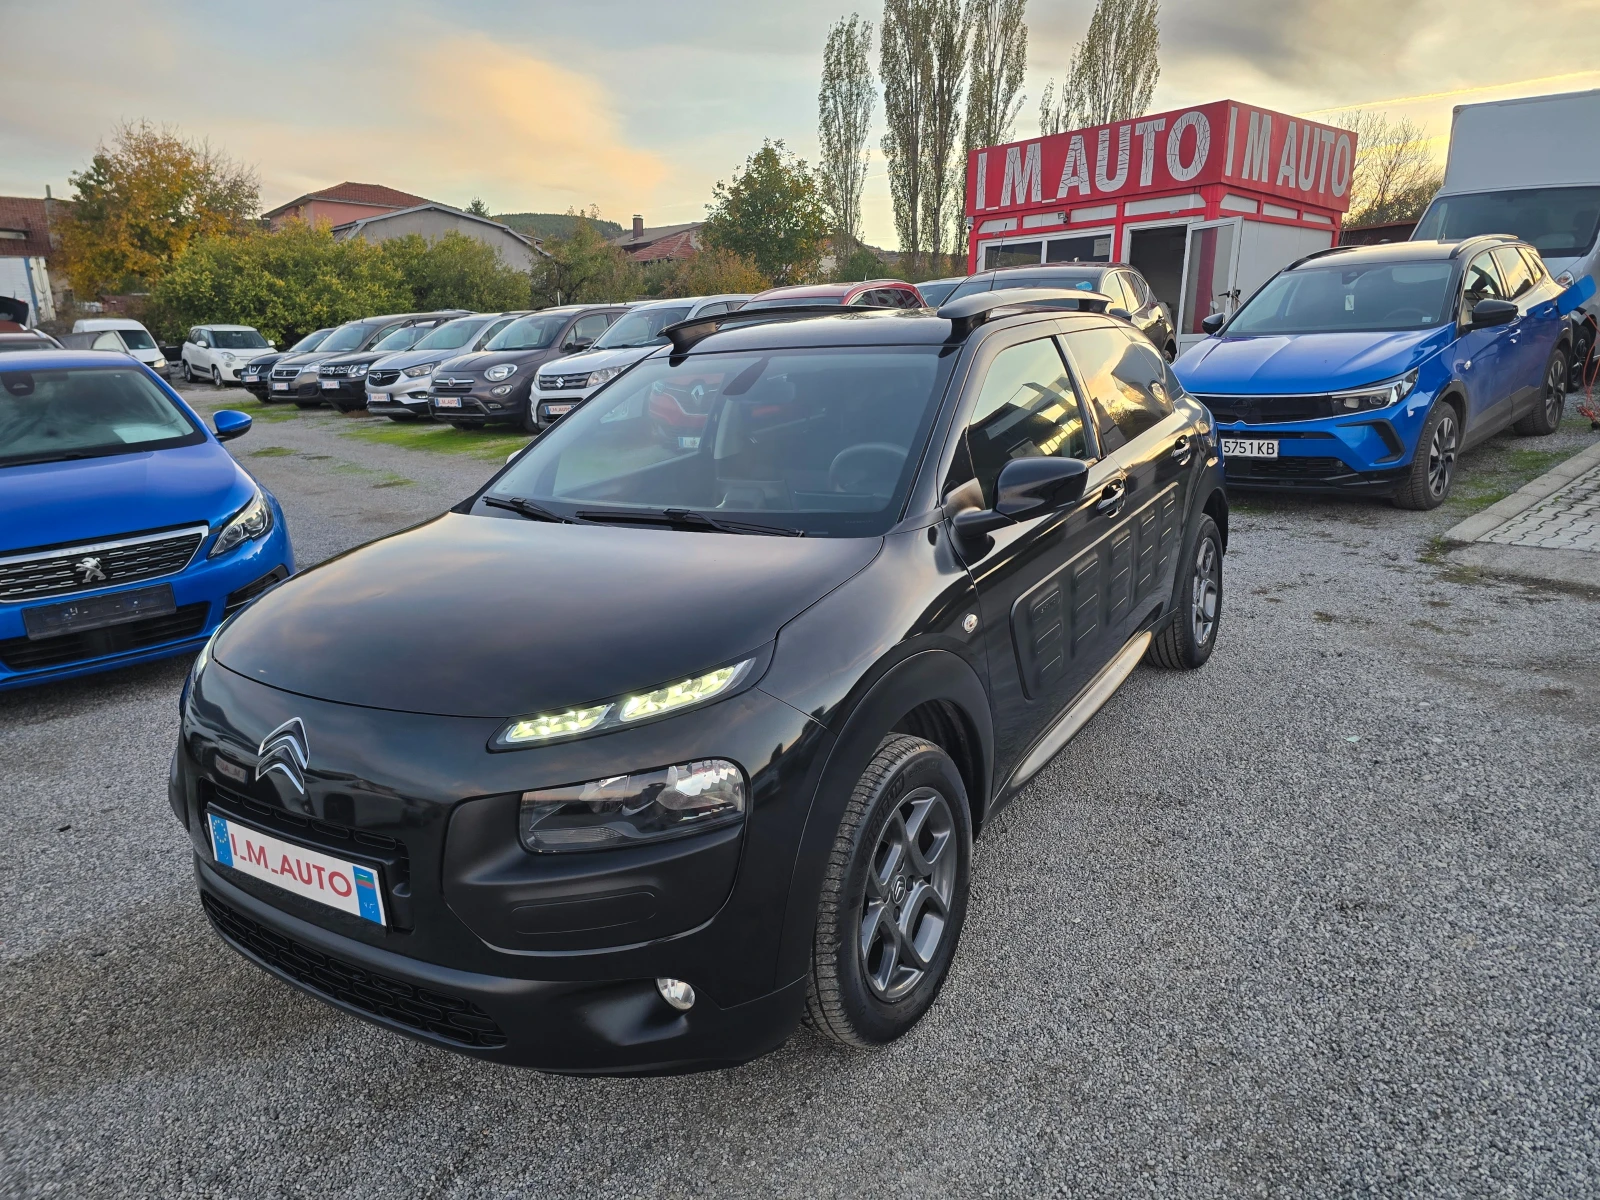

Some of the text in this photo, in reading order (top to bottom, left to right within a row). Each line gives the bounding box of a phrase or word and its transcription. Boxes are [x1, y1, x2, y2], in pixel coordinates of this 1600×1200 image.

[1242, 110, 1272, 183] M
[1276, 121, 1351, 198] AUTO
[1223, 441, 1275, 455] 5751 KB
